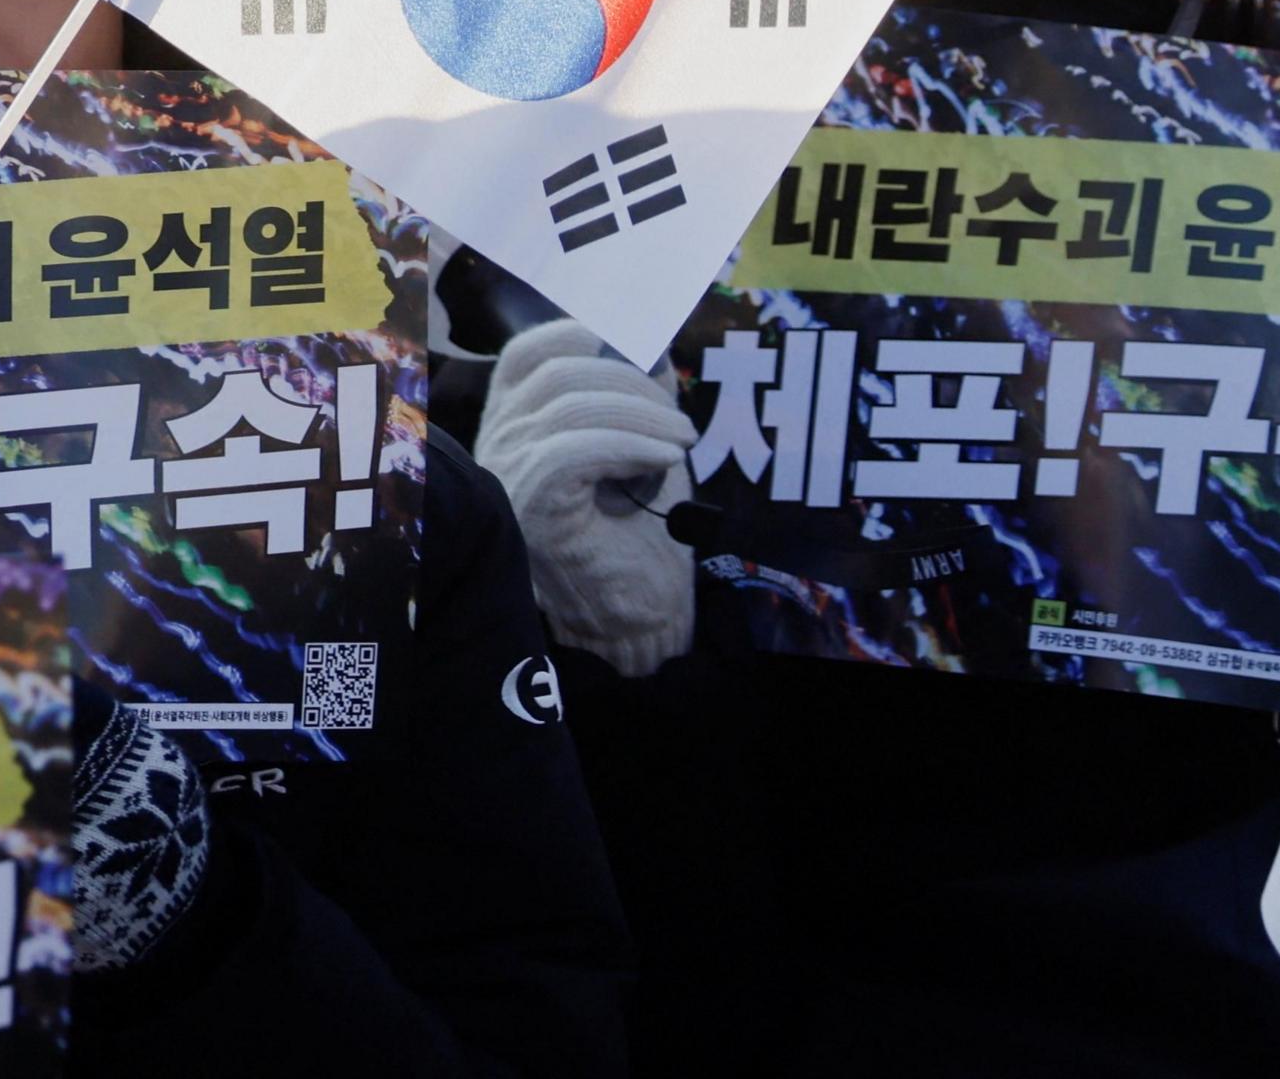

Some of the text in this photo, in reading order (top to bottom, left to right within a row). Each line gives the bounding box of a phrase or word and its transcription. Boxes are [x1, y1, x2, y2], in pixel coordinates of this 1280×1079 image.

[771, 161, 1165, 274] 내란수괴
[39, 200, 328, 319] 윤석열
[911, 548, 966, 581] ARMY
[1072, 609, 1118, 628] 시민후원
[1037, 631, 1097, 651] 카카오뱅크
